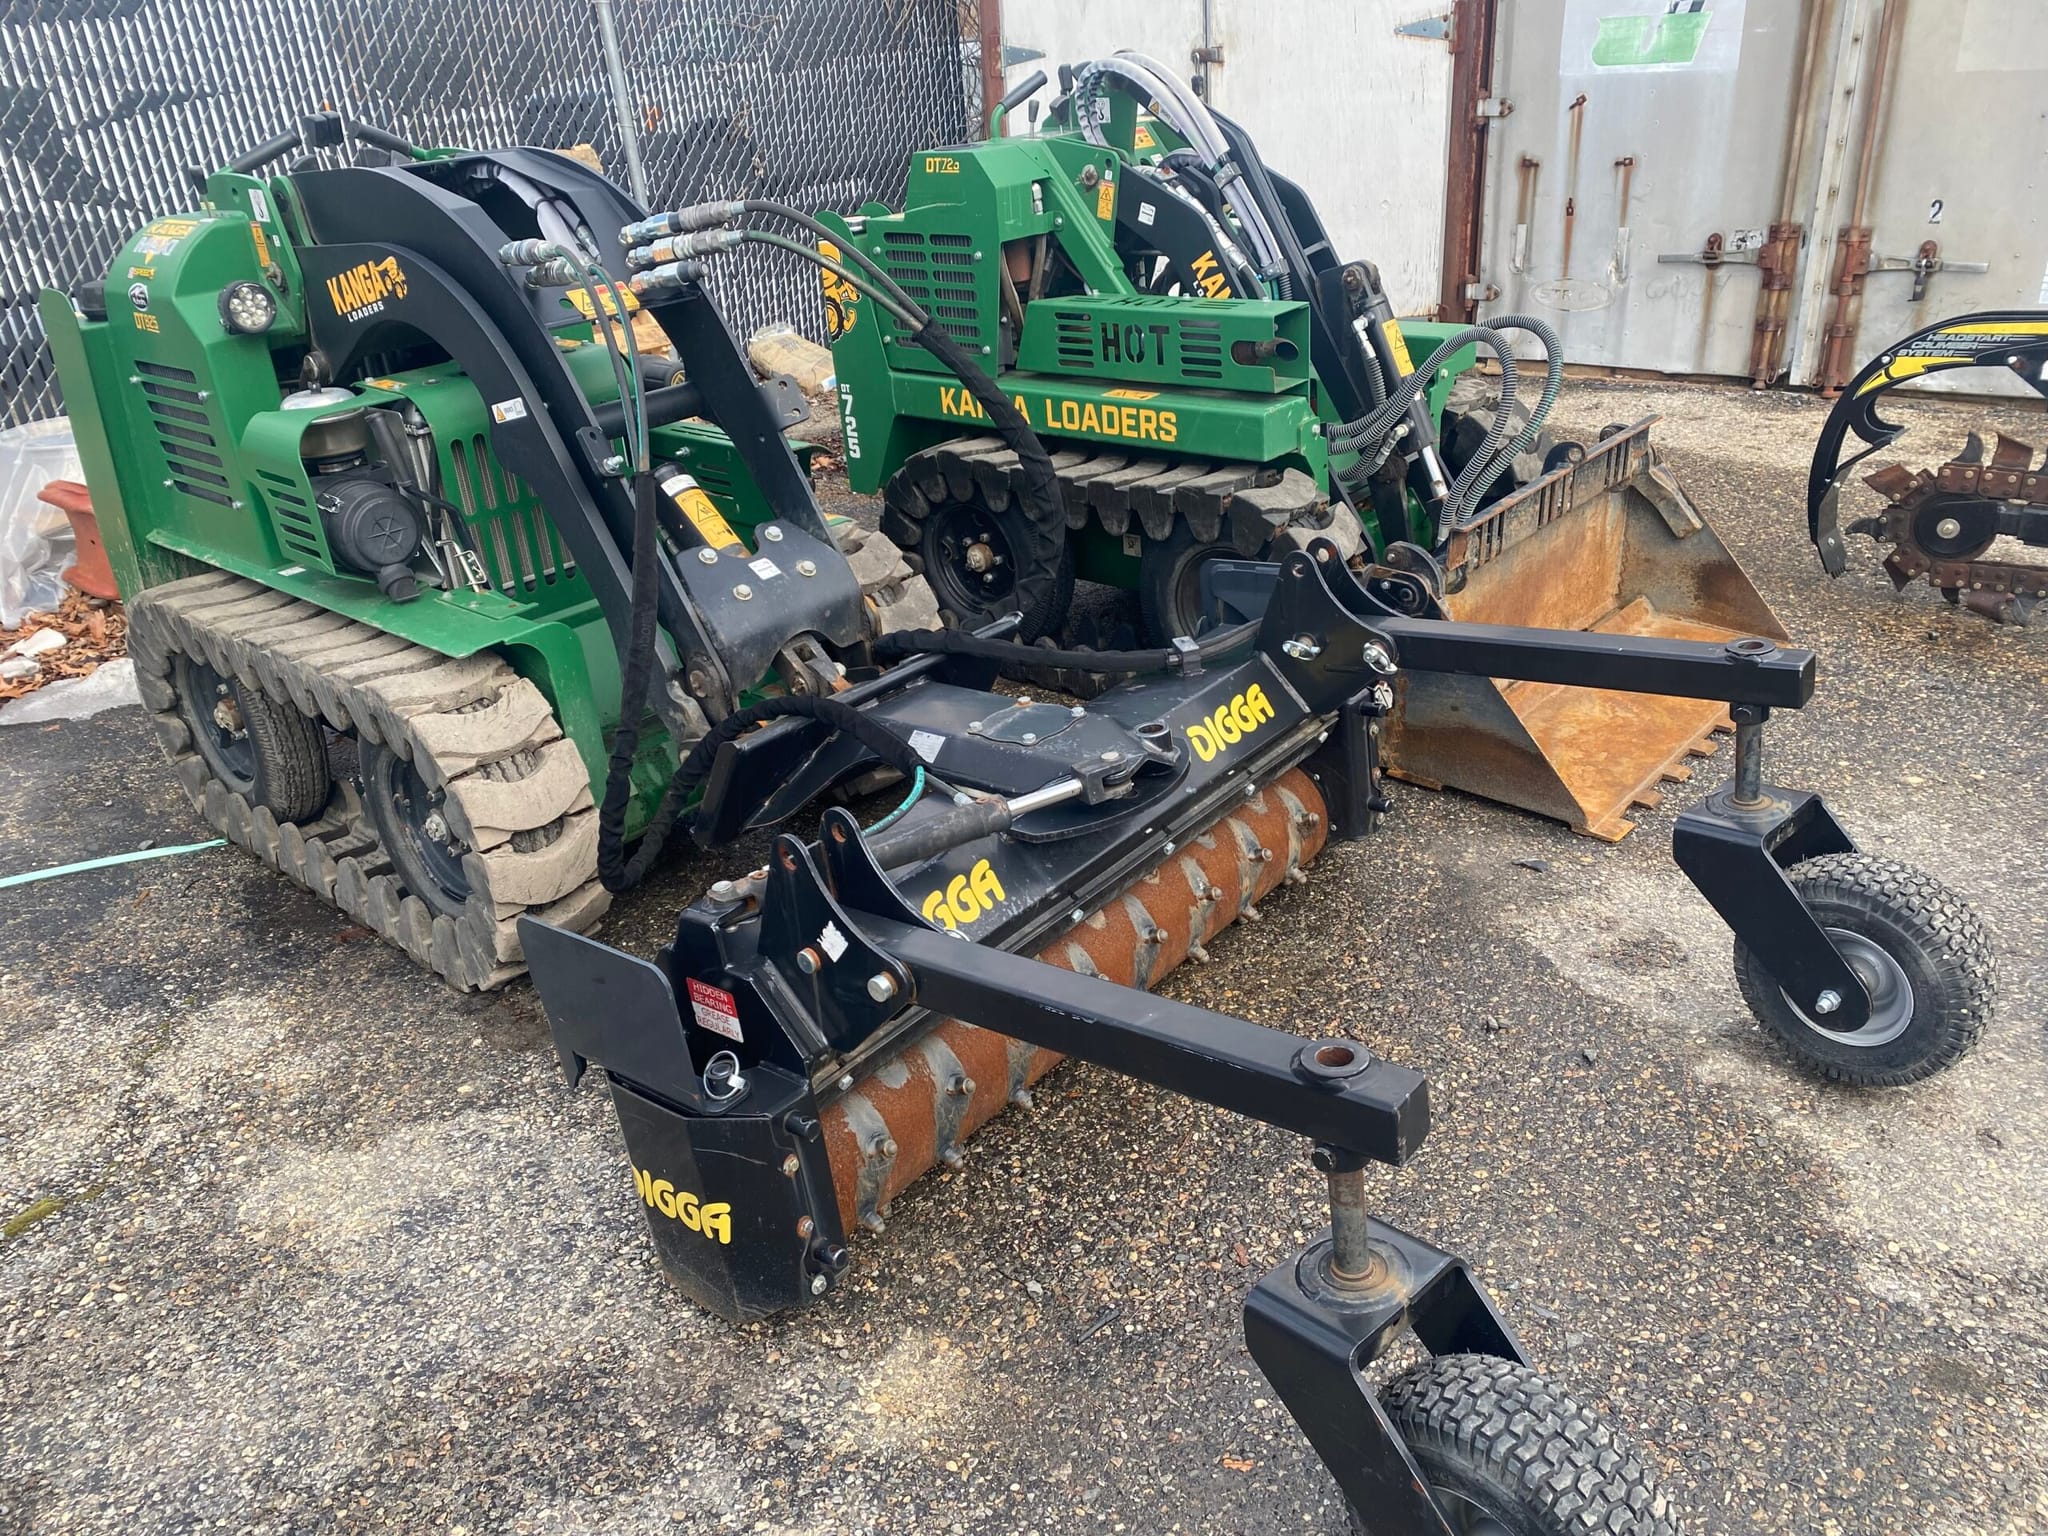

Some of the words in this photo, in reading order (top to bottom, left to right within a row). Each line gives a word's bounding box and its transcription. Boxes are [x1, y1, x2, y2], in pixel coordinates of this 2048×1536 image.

[1928, 199, 1944, 224] 2
[326, 260, 389, 316] KANGA
[347, 301, 385, 323] LOADERS
[1100, 322, 1170, 366] HOT
[1926, 333, 2011, 342] HEADSTART
[1897, 349, 1954, 357] SYSTEM
[841, 393, 861, 459] 725
[939, 386, 1031, 425] KAA
[1045, 398, 1178, 442] LOADERS
[1186, 683, 1275, 762] DIGGA
[693, 982, 728, 1002] HIDDEN
[693, 992, 733, 1015] BEARING
[701, 1007, 731, 1025] GREASE
